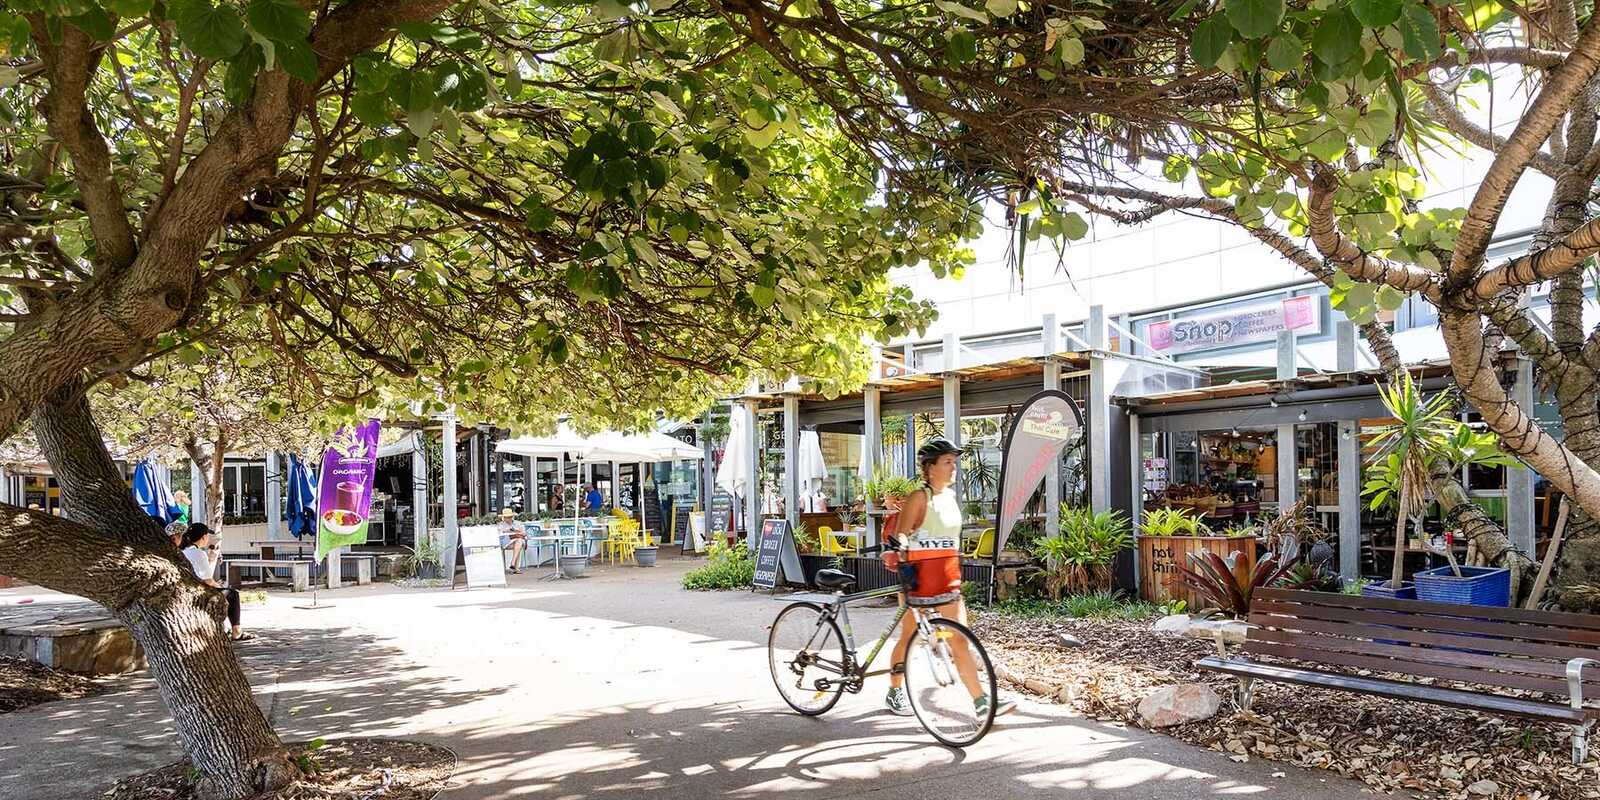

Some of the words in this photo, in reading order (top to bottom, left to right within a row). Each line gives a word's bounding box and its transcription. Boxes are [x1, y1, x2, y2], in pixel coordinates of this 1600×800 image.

[1174, 319, 1232, 343] Shop
[919, 540, 955, 549] MYER
[1152, 544, 1176, 558] hot
